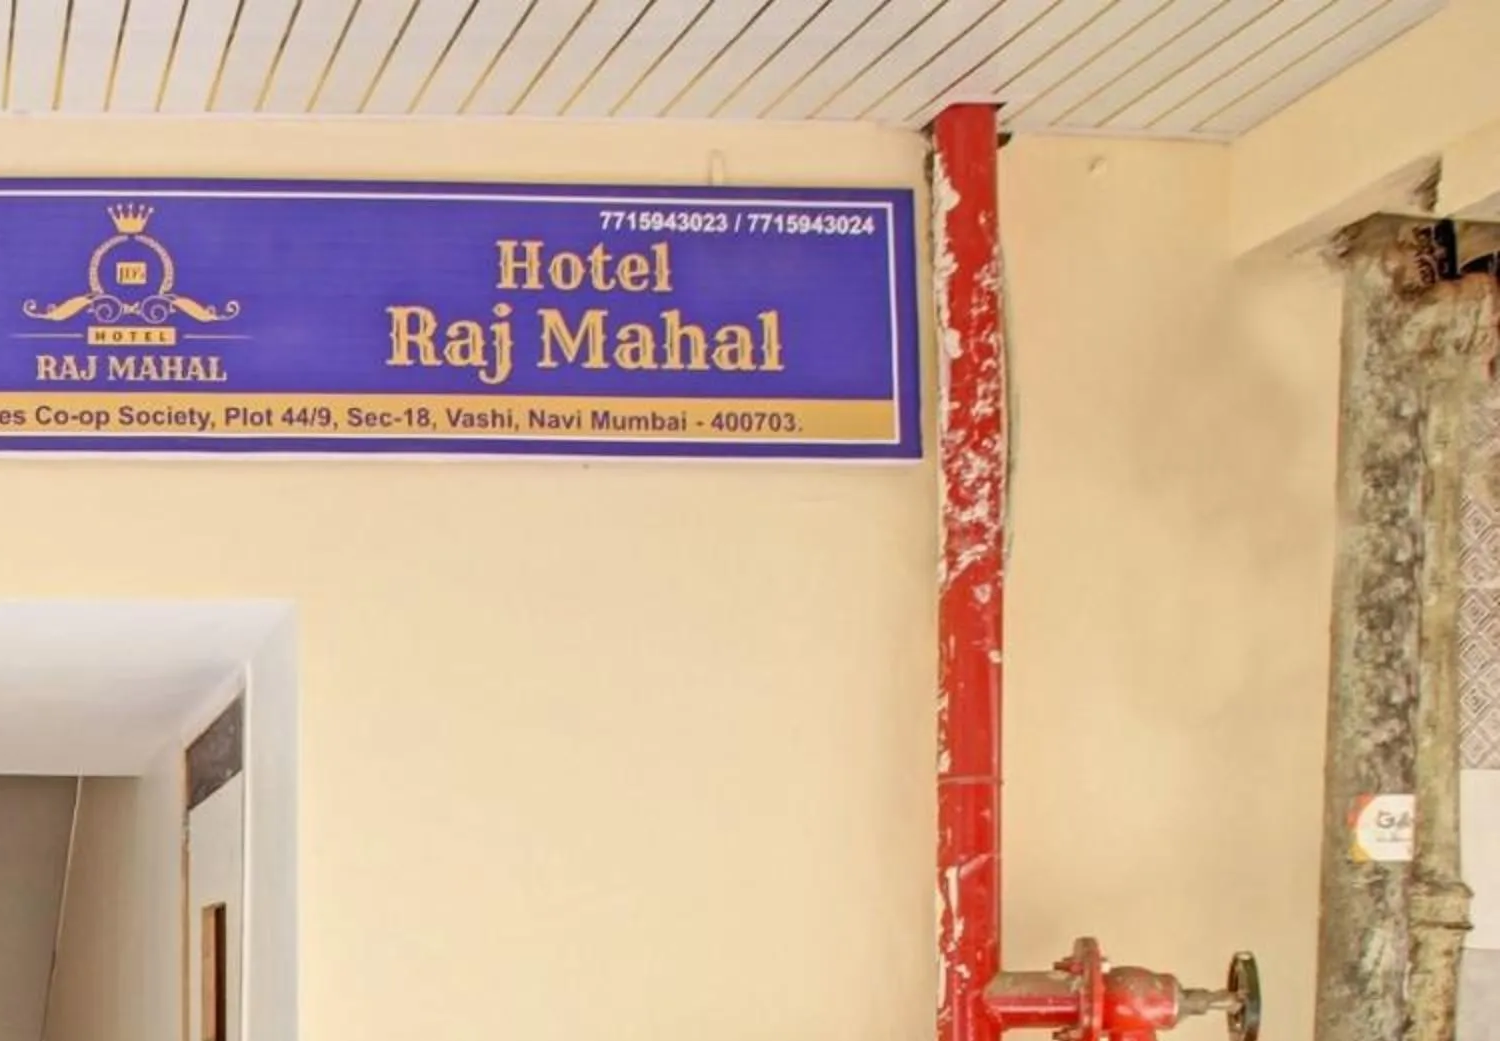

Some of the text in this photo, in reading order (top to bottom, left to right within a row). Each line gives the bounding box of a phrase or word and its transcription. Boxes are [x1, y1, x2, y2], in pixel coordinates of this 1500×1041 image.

[599, 210, 729, 233] 7715943023
[746, 213, 876, 236] 7715943024
[496, 240, 672, 292] Hotel
[94, 331, 167, 343] HOTEL
[386, 303, 785, 385] Raj Mahal
[36, 354, 228, 382] RAJ MAHAL
[34, 405, 110, 430] Co-op
[118, 405, 216, 432] Society,
[225, 406, 273, 427] Plot
[280, 406, 339, 430] 44/9,
[347, 407, 437, 430] Sec-18,
[446, 408, 520, 432] Vashi,
[528, 409, 582, 430] Navi
[591, 410, 687, 432] Mumbai
[710, 412, 803, 433] 400703.
